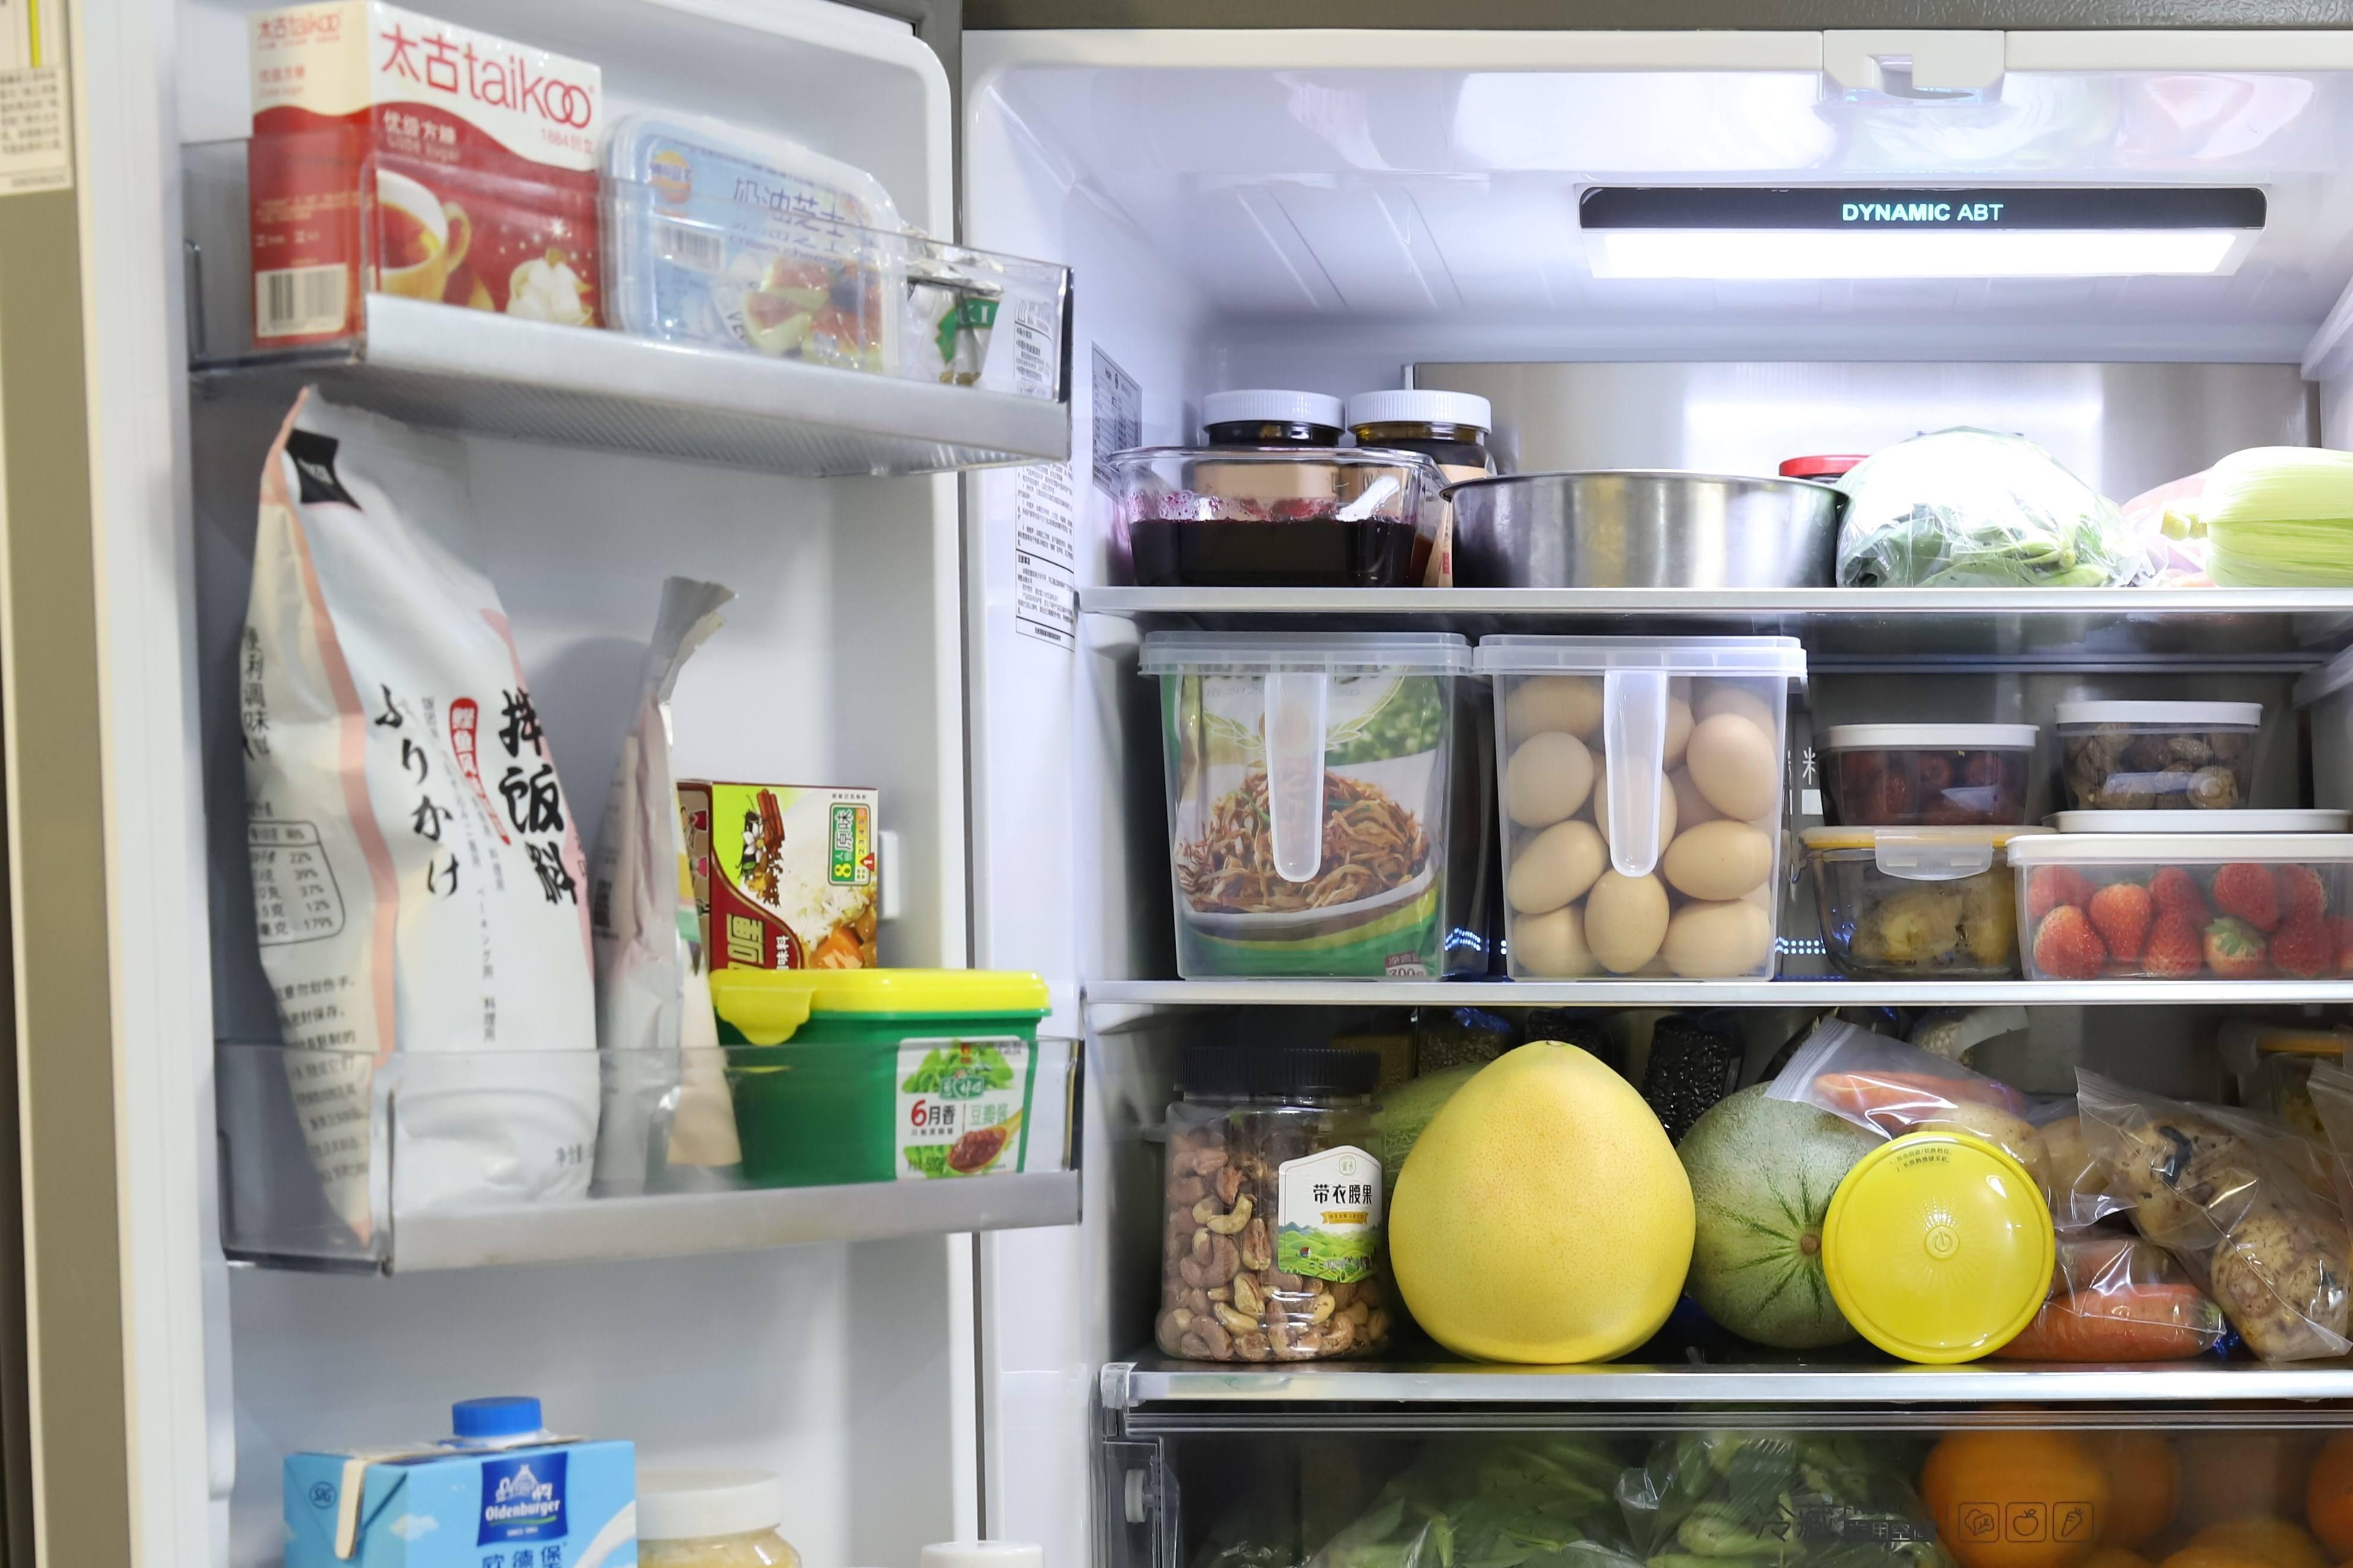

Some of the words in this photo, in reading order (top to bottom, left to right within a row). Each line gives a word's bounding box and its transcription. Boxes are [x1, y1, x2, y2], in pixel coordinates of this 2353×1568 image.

[1842, 203, 1951, 221] DYNAMIC
[1957, 203, 2004, 221] ABT
[836, 807, 853, 851] 原味
[835, 863, 851, 878] 8
[911, 1099, 955, 1127] 6月香
[1313, 1184, 1372, 1204] 带衣腰果
[485, 1500, 561, 1522] Oldenburger
